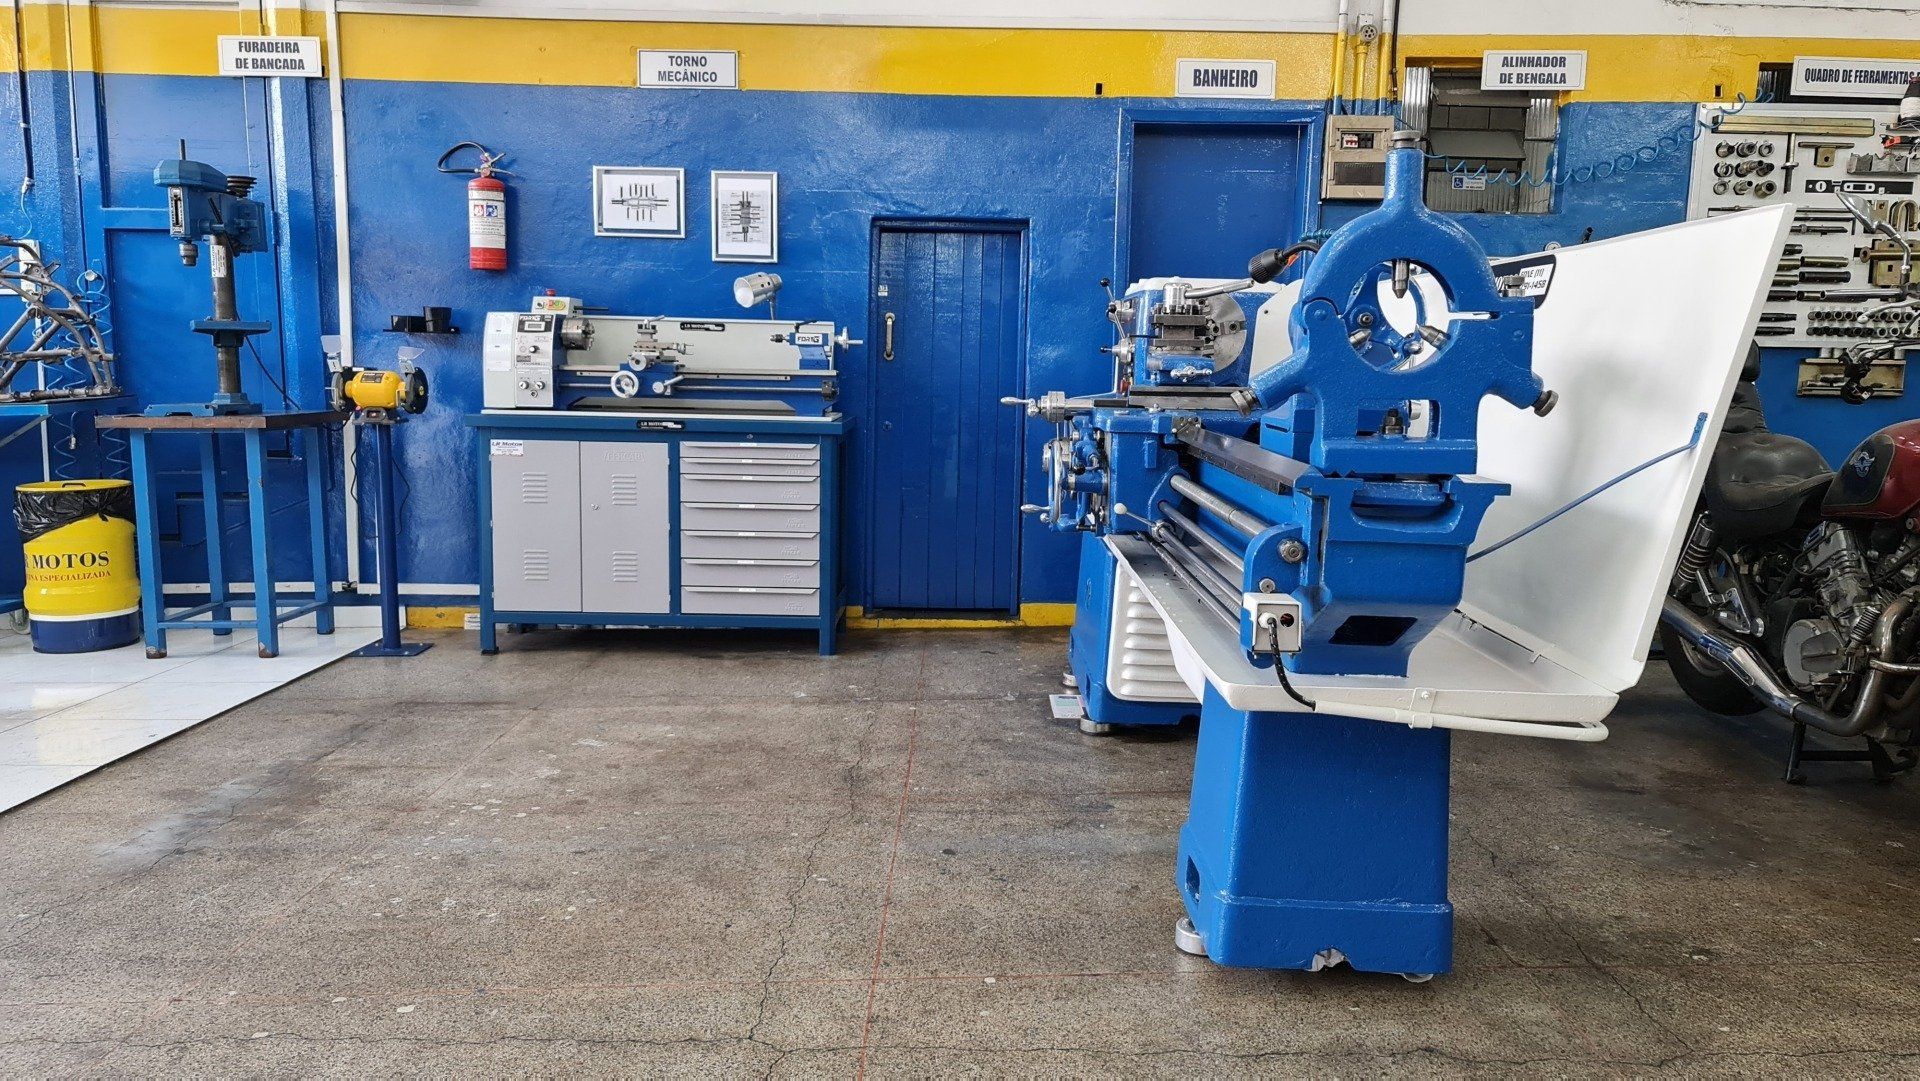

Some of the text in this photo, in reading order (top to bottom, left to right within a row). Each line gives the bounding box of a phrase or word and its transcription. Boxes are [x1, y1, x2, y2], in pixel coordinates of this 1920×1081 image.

[238, 41, 300, 53] FURADEIRA
[235, 58, 306, 70] DE BANCADA
[668, 55, 708, 67] TORNO
[1501, 56, 1567, 68] ALINHADOR
[658, 69, 718, 83] MECÂNICO
[1193, 68, 1258, 88] BANHEIRO
[1499, 73, 1567, 84] DE BENGALA
[1804, 68, 1840, 83] QUADRO
[1841, 69, 1853, 83] DE
[32, 551, 110, 570] MOTOS
[39, 570, 112, 582] ESPECIALIZADA
